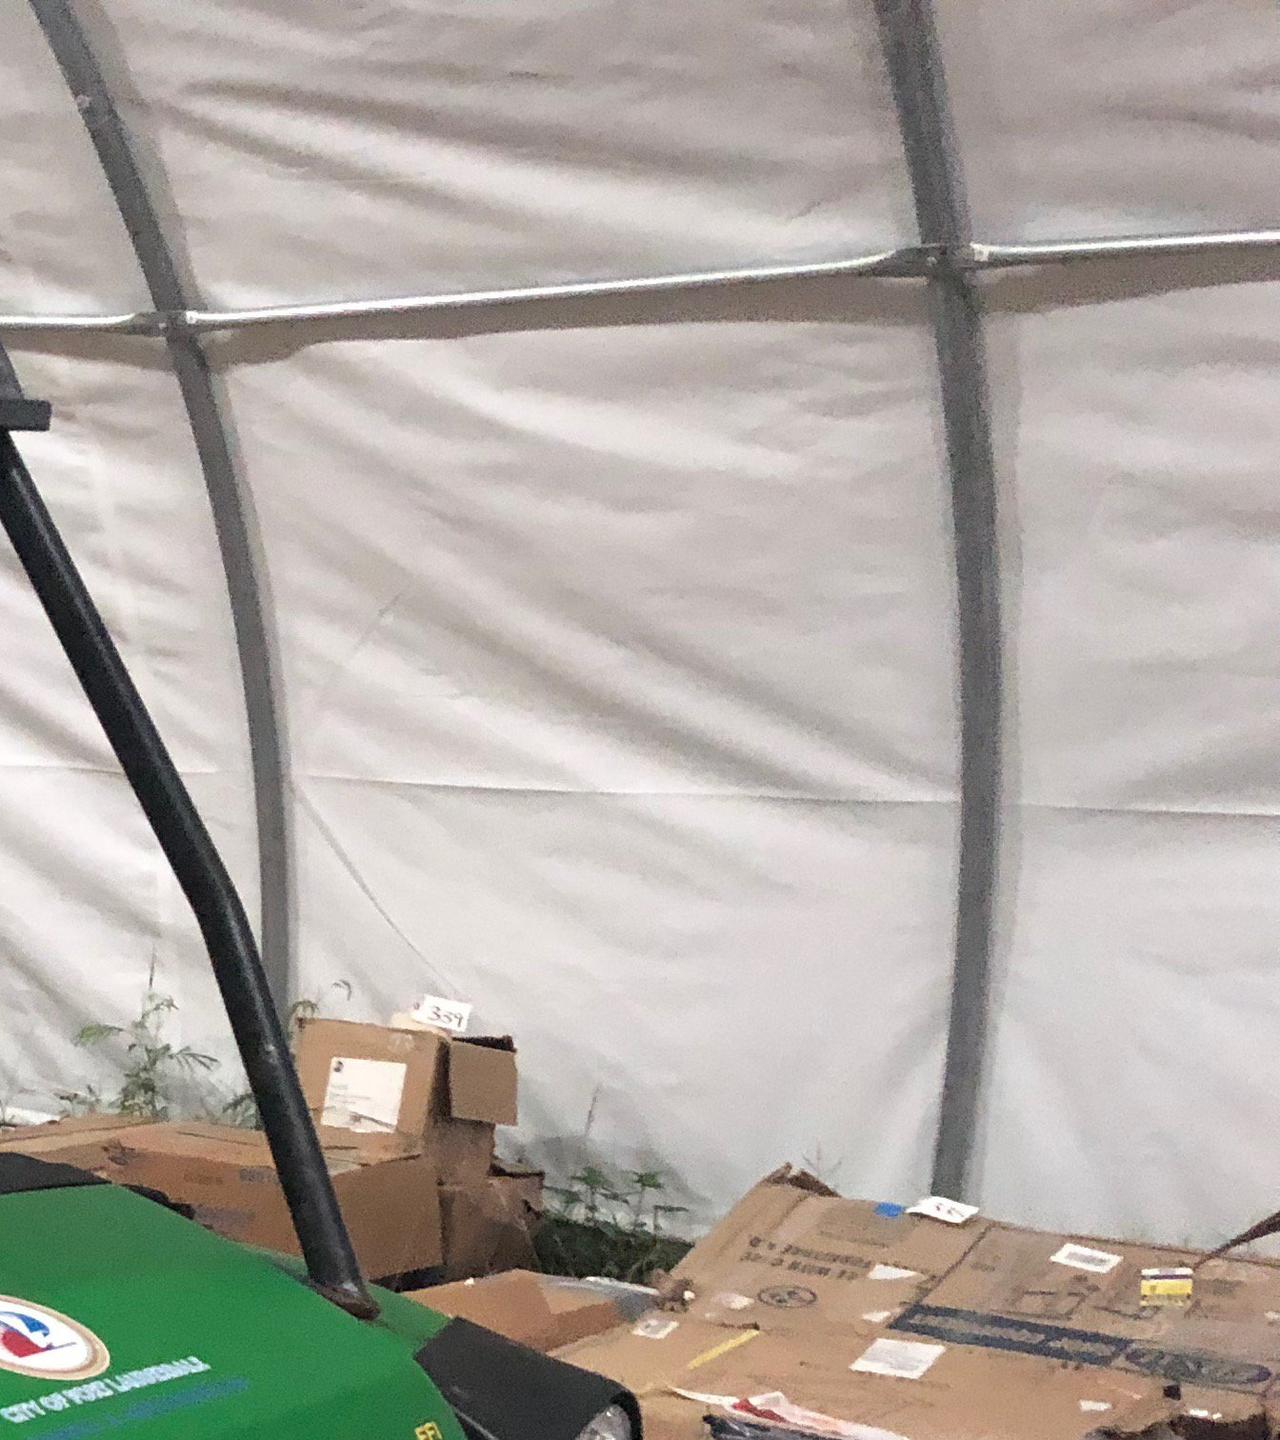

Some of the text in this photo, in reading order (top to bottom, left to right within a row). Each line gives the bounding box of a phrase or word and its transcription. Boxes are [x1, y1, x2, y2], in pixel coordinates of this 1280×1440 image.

[428, 1005, 464, 1028] 359
[0, 1400, 46, 1424] CITY
[40, 1392, 70, 1411] OF
